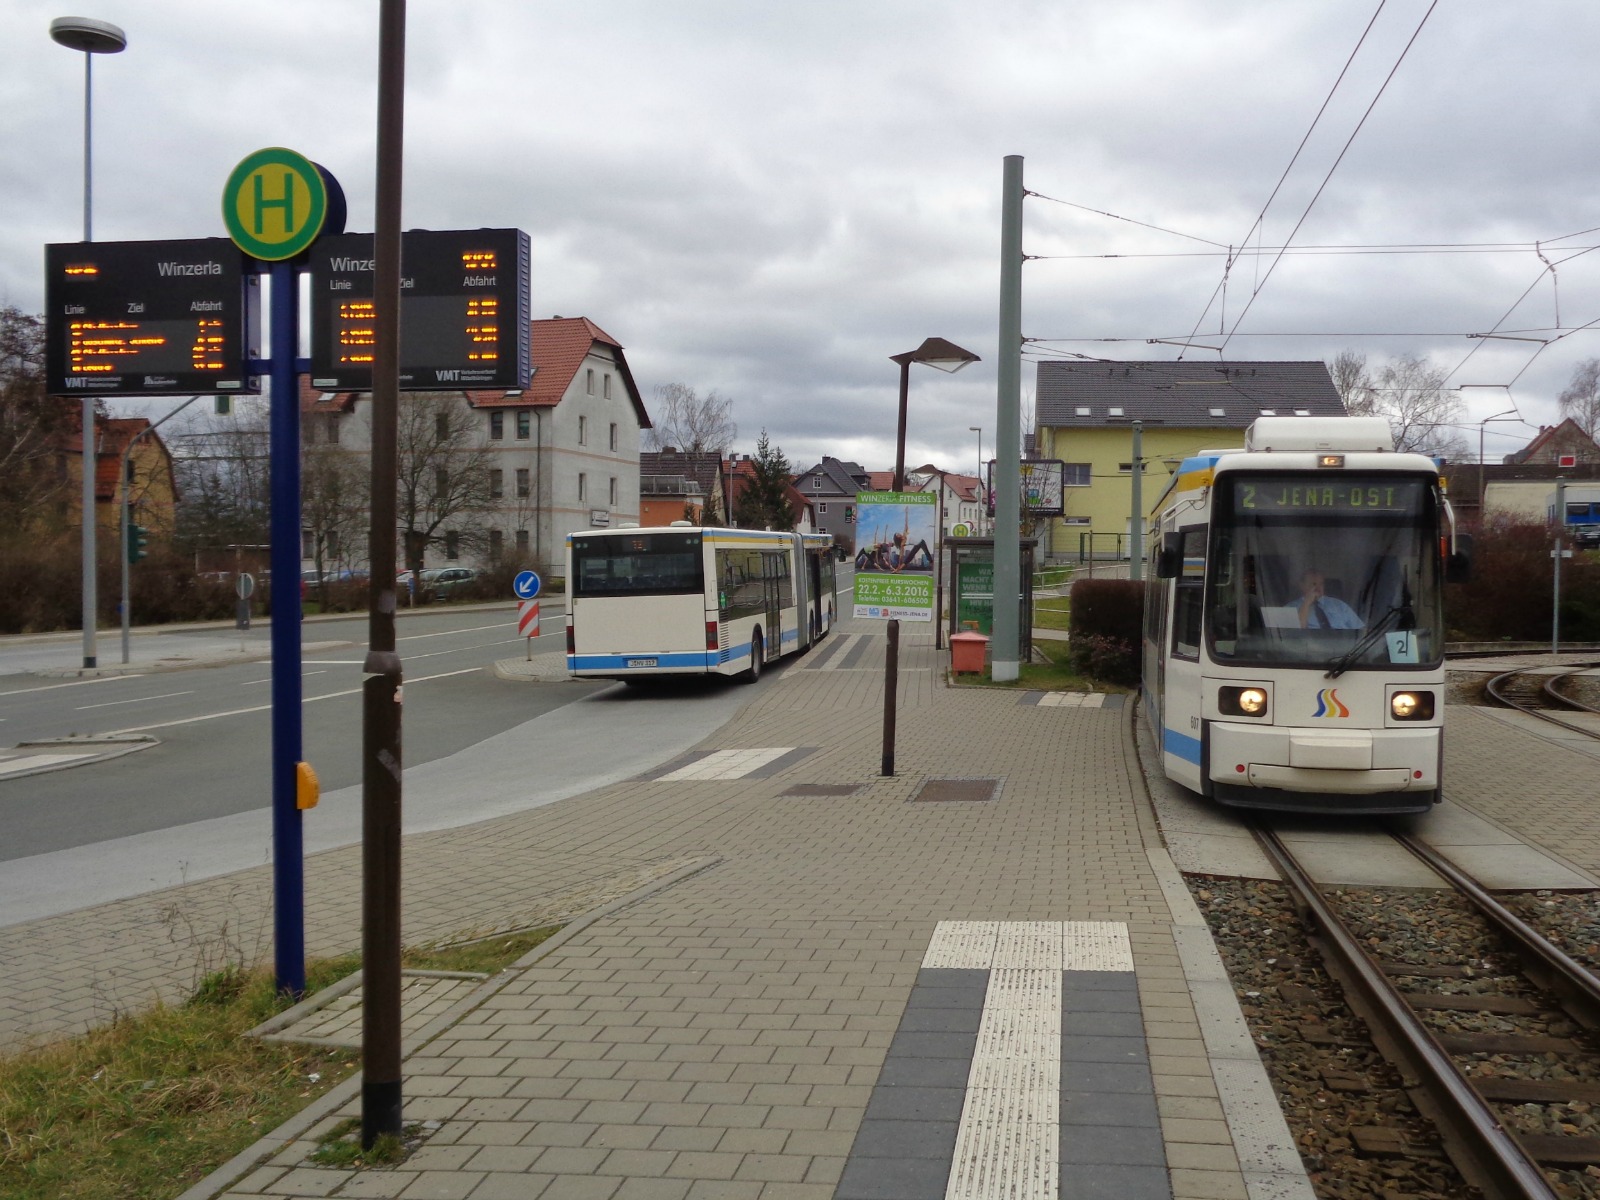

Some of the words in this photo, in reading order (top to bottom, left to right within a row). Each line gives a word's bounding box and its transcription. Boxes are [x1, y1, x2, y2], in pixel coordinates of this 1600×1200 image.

[253, 173, 294, 234] H
[158, 261, 222, 276] Winzerla
[330, 257, 376, 271] Winze
[330, 280, 351, 290] Linie
[463, 276, 496, 287] Abfahrt
[65, 304, 85, 314] Linie
[128, 303, 144, 313] Ziel
[190, 301, 222, 312] Abfahrt
[435, 370, 460, 381] VMT
[65, 377, 88, 388] VMT
[899, 495, 931, 503] FITNESS
[1242, 485, 1256, 508] 2
[1276, 487, 1395, 506] JENA-OST
[858, 594, 880, 602] Telefon:
[1397, 640, 1406, 654] 2
